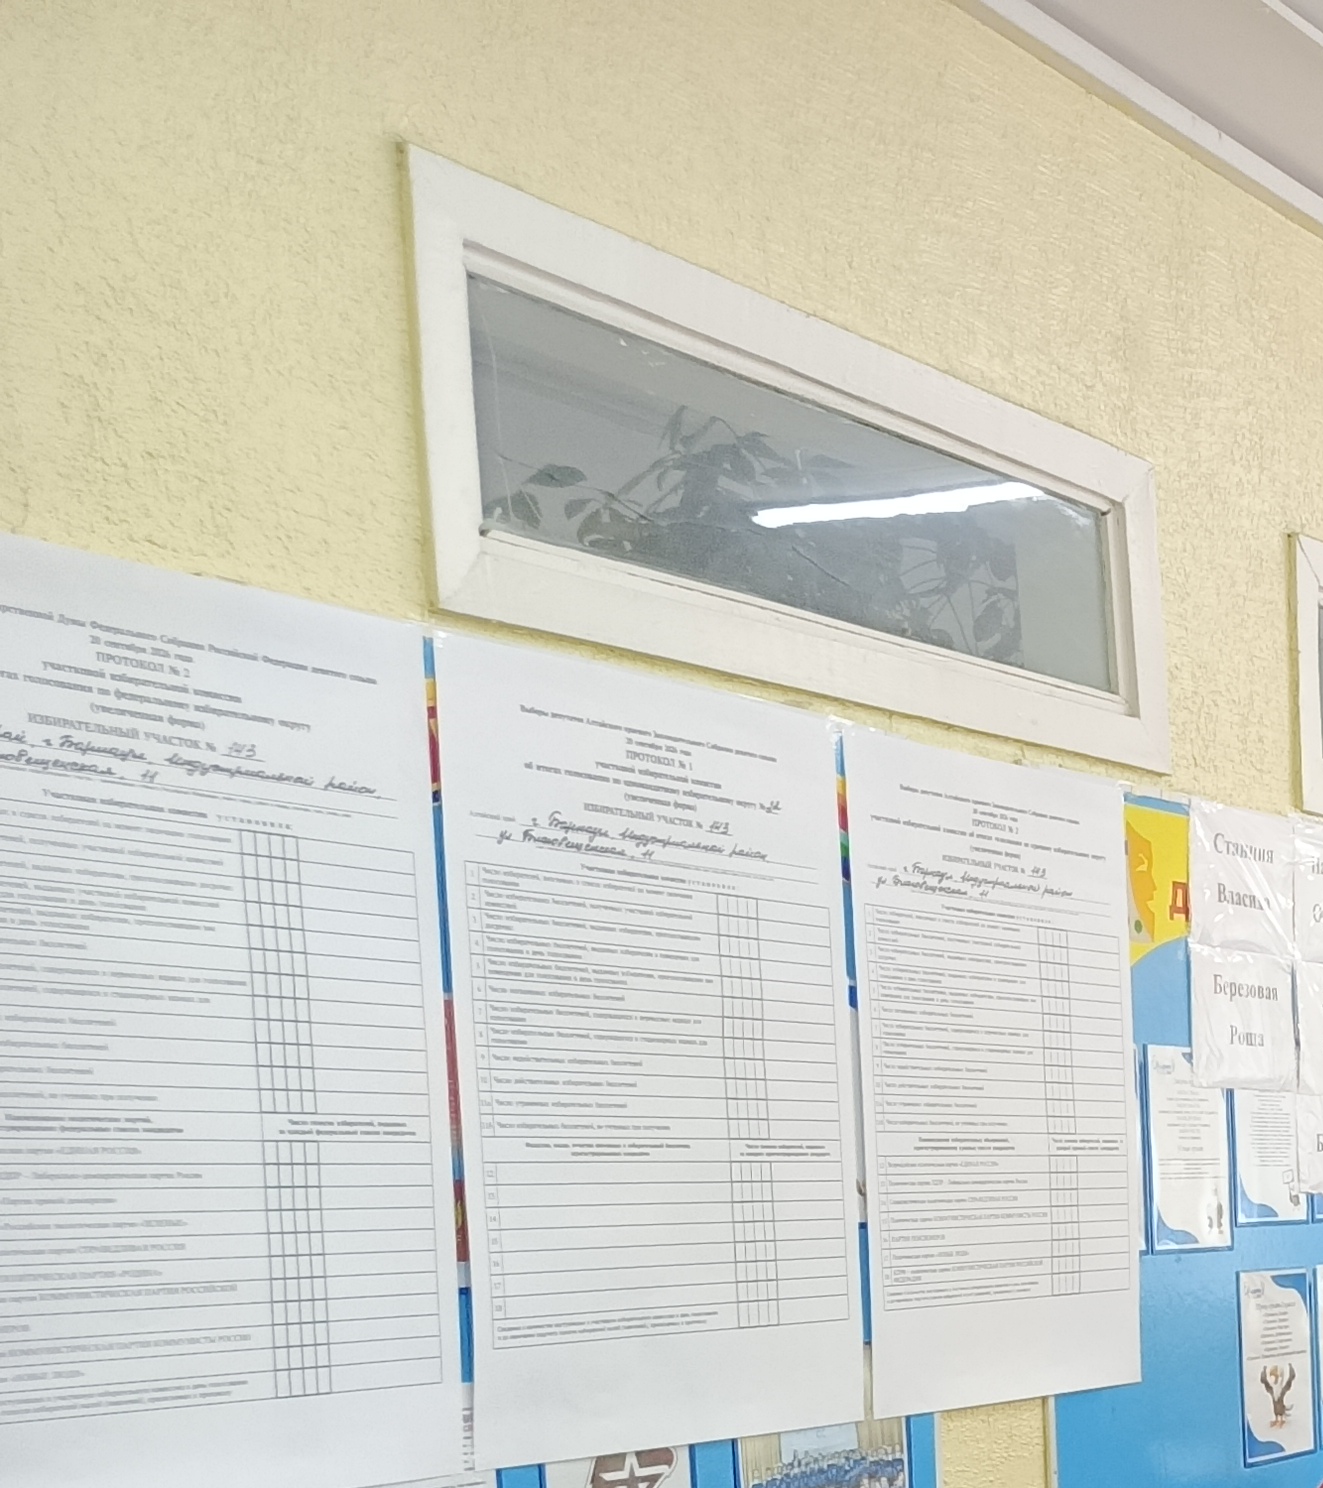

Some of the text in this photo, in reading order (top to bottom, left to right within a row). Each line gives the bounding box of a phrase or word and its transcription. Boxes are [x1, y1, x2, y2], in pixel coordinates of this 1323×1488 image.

[96, 651, 164, 673] ПРОТОКОЛ
[27, 712, 140, 740] ИЗБИРАТЕЛЬНЫЙ
[143, 731, 202, 750] УЧАСТОК
[626, 750, 675, 767] ПРОТОКОЛ
[1213, 974, 1278, 1002] Березовая
